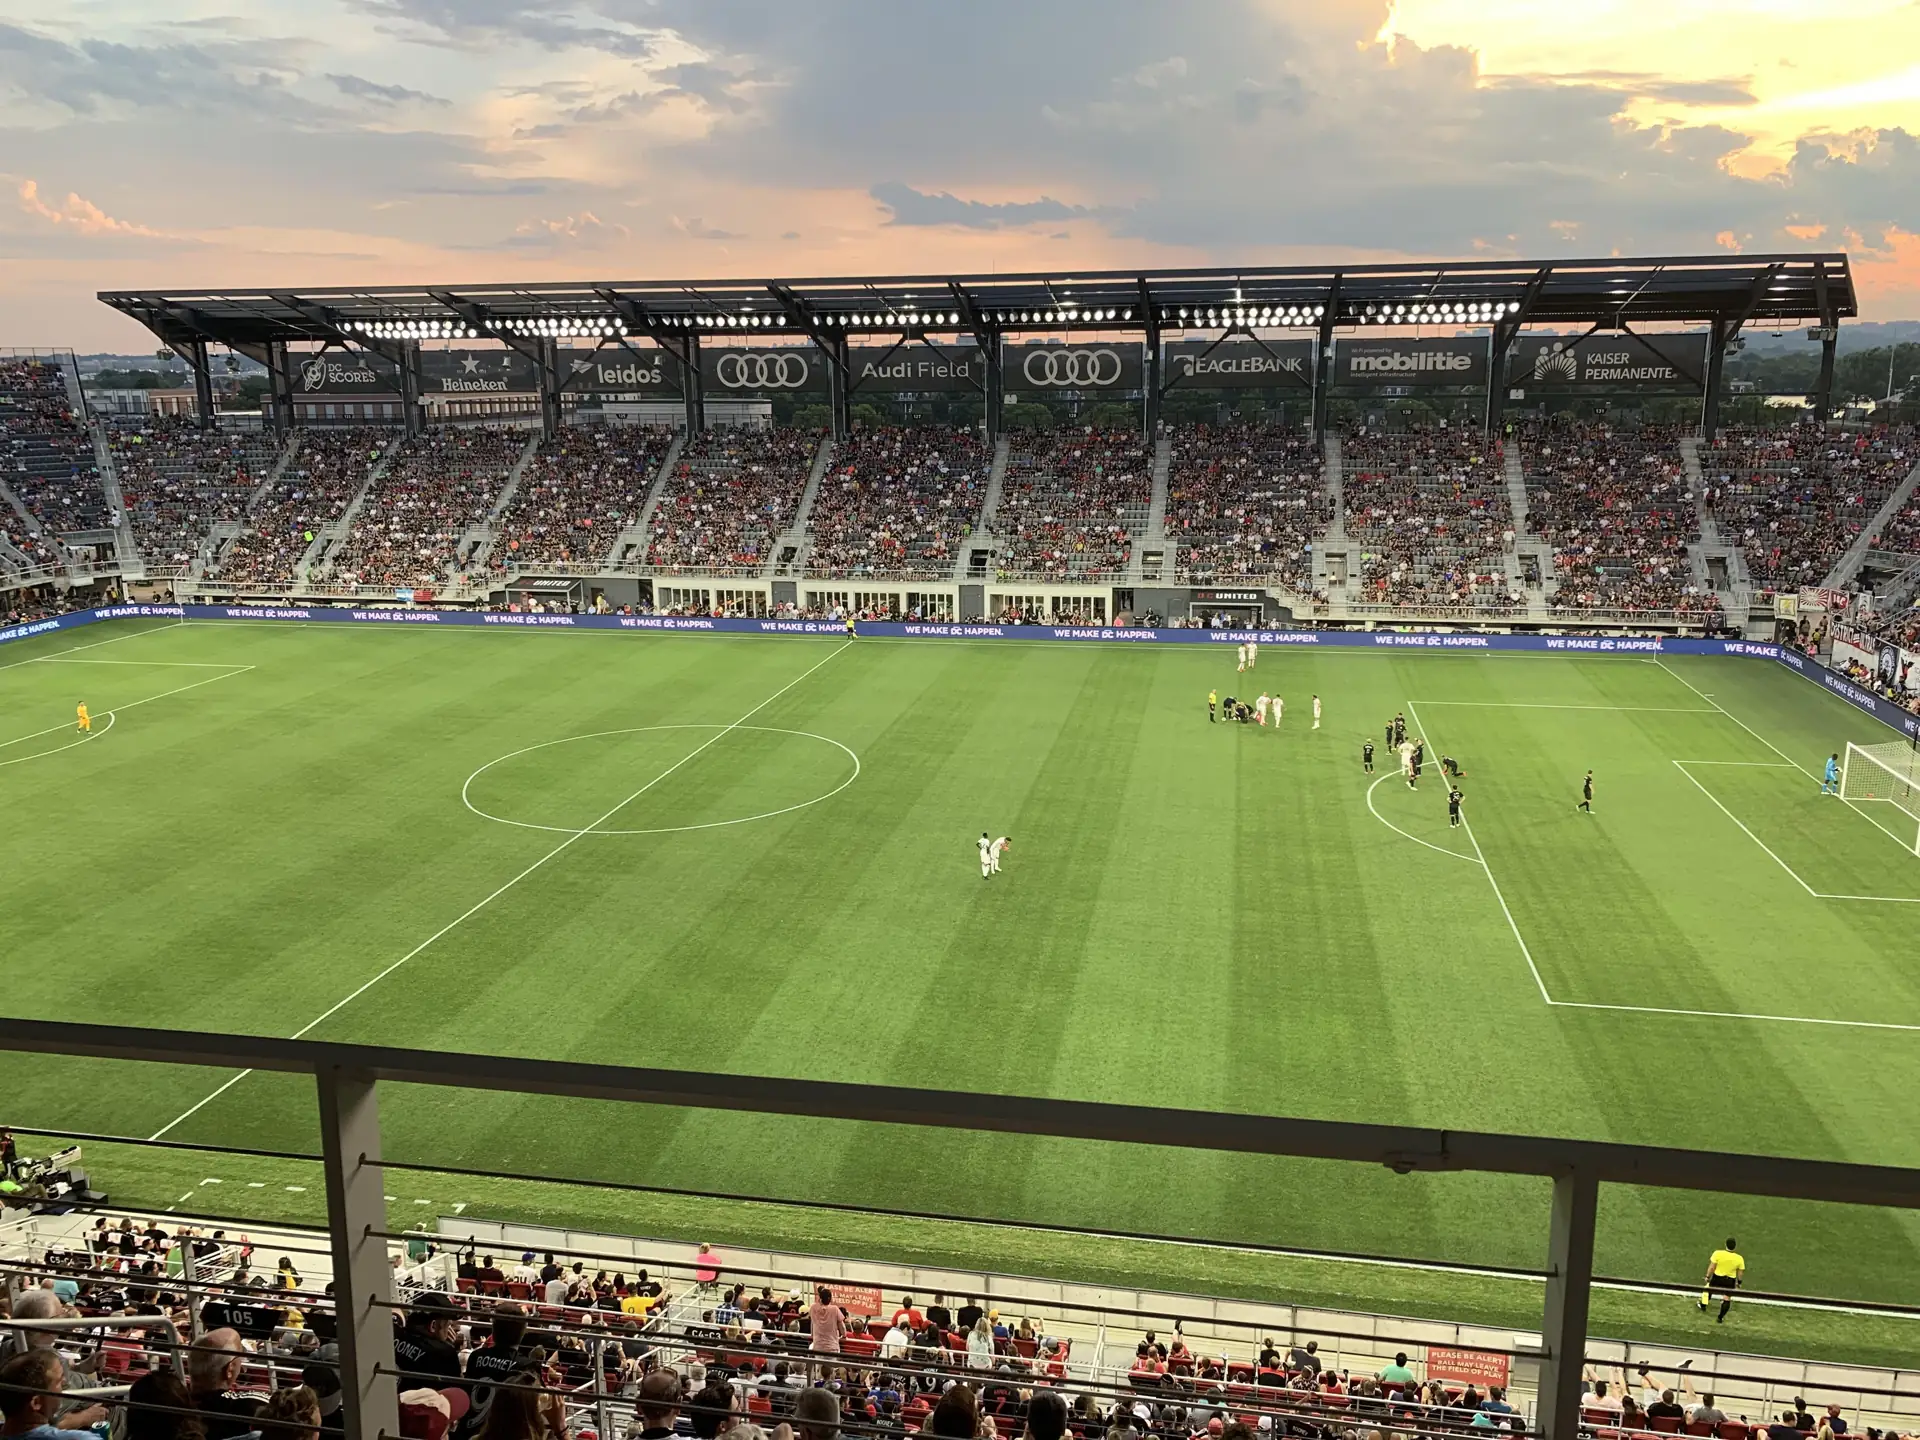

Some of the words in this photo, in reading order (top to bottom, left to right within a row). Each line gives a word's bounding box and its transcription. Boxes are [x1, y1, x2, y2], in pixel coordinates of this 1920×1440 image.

[1350, 351, 1471, 371] mobilitie
[1586, 352, 1629, 365] KAISER
[328, 364, 342, 373] DC
[861, 361, 912, 378] Audi
[918, 361, 969, 378] Field
[1195, 357, 1303, 373] EAGLEBANK
[328, 372, 376, 384] SCORES
[597, 364, 662, 384] leidos
[1585, 367, 1673, 380] PERMANENTE
[442, 377, 507, 391] Heineken
[95, 610, 110, 618] WE
[112, 607, 139, 616] MAKE
[152, 607, 185, 615] HAPPEN.
[227, 609, 240, 617] WE
[242, 609, 264, 617] MAKE
[278, 610, 310, 618] HAPPEN.
[353, 612, 367, 620] WE
[368, 612, 391, 620] MAKE
[405, 613, 440, 621] HAPPEN.
[484, 615, 499, 623] WE
[500, 615, 524, 623] MAKE
[539, 617, 574, 625] HAPPEN.
[621, 618, 636, 626] WE
[637, 619, 662, 627] MAKE
[677, 620, 714, 628] HAPPEN.
[29, 621, 60, 634] HAPPEN.
[761, 622, 776, 630] WE
[778, 623, 803, 631] MAKE
[819, 624, 856, 632] HAPPE.
[905, 626, 922, 634] WE
[923, 626, 948, 635] MAKE
[964, 628, 1003, 636] HAPPEN.
[1054, 629, 1071, 638] WE
[1072, 630, 1099, 638] MAKE
[1116, 630, 1157, 639] HAPPEN.
[1211, 632, 1228, 640] WE
[1230, 632, 1258, 641] MAKE
[1276, 634, 1318, 642] HAPPEN.
[1375, 635, 1393, 644] WE
[1395, 636, 1424, 645] MAKE
[1443, 637, 1488, 646] HAPPEN.
[1547, 639, 1565, 648] WE
[1567, 639, 1598, 649] MAKE
[1617, 640, 1663, 650] HAPPEN.
[1724, 643, 1743, 653] WE
[1746, 645, 1778, 657] MAKE
[855, 1287, 878, 1297] ALERT!
[855, 1295, 874, 1303] LEAVE
[862, 1302, 878, 1310] PLAY.
[223, 1309, 253, 1325] 105
[393, 1338, 426, 1362] OONEY
[476, 1355, 517, 1371] ROONEY
[1431, 1351, 1461, 1359] PLEASE
[1476, 1354, 1505, 1366] ALERT!
[1475, 1363, 1499, 1372] LEAVE
[1483, 1370, 1504, 1380] PLAY.
[925, 1376, 937, 1393] 9
[467, 1377, 497, 1429] 9
[996, 1396, 1006, 1415] 7
